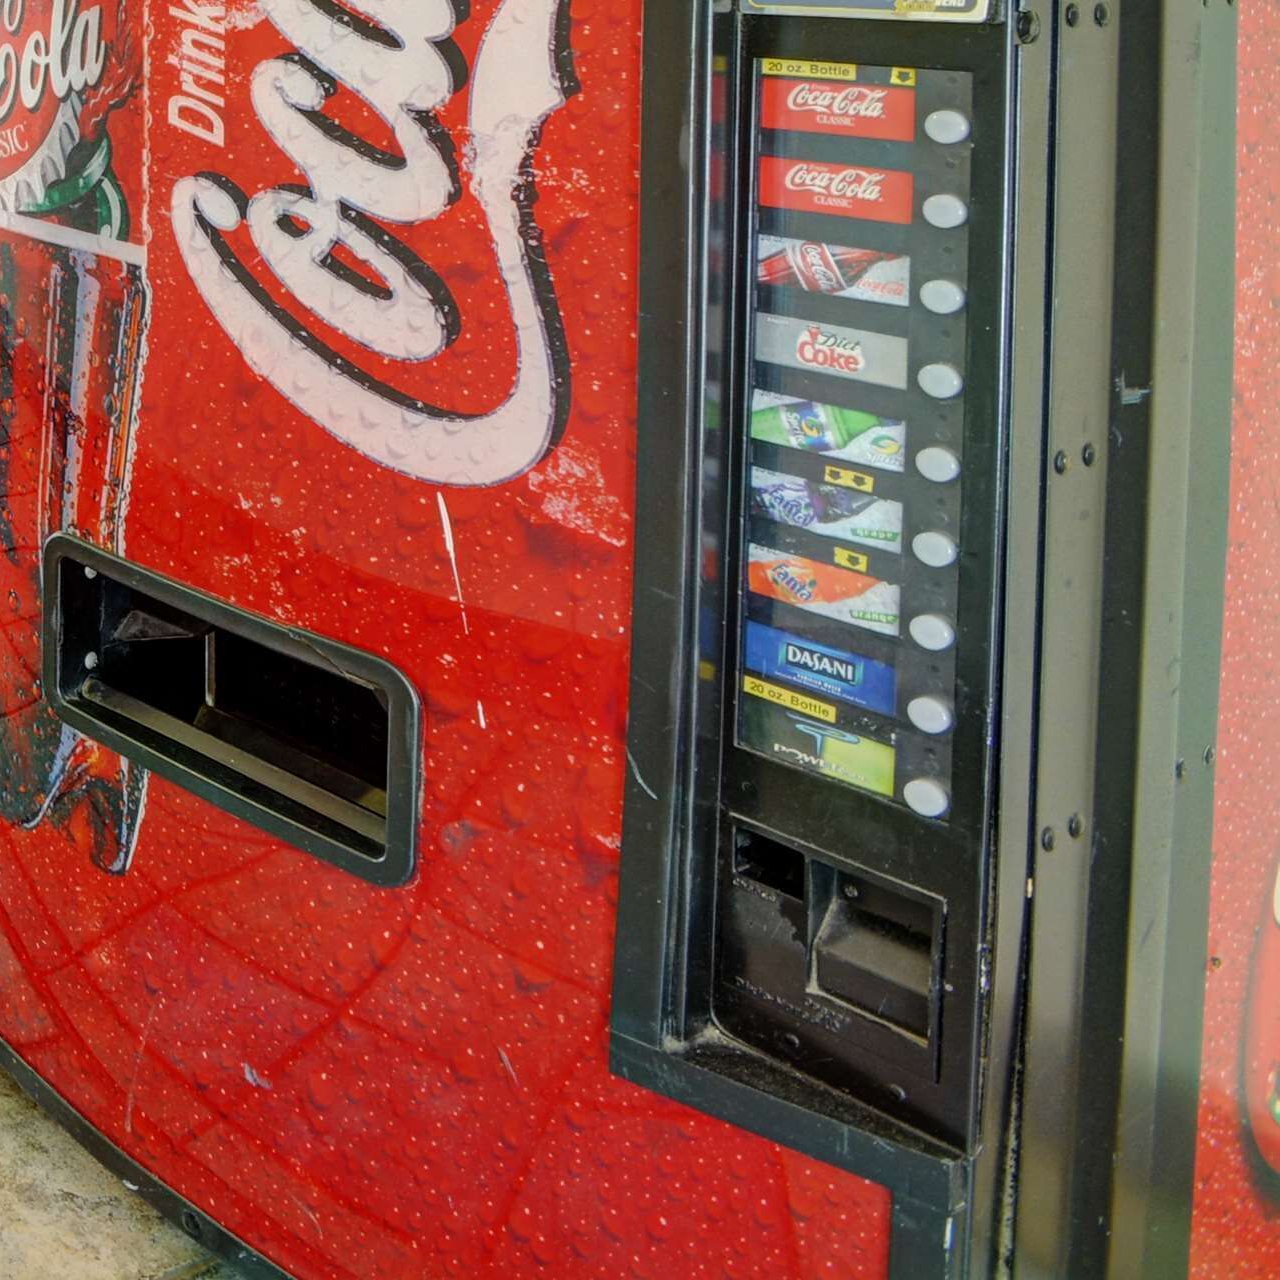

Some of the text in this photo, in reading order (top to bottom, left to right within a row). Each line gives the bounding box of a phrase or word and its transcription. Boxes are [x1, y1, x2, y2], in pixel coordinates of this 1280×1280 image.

[768, 62, 850, 77] 20 oz. Bottle
[787, 83, 889, 118] Coca-Cola
[817, 114, 855, 127] CLASSIC
[785, 163, 885, 202] Coca-Cola
[814, 195, 853, 209] CLASSIC
[798, 340, 859, 372] Coke
[819, 329, 861, 352] Diet
[771, 563, 813, 603] Fanta
[786, 644, 854, 682] DASANI
[750, 681, 830, 718] 20 oz. Bottle
